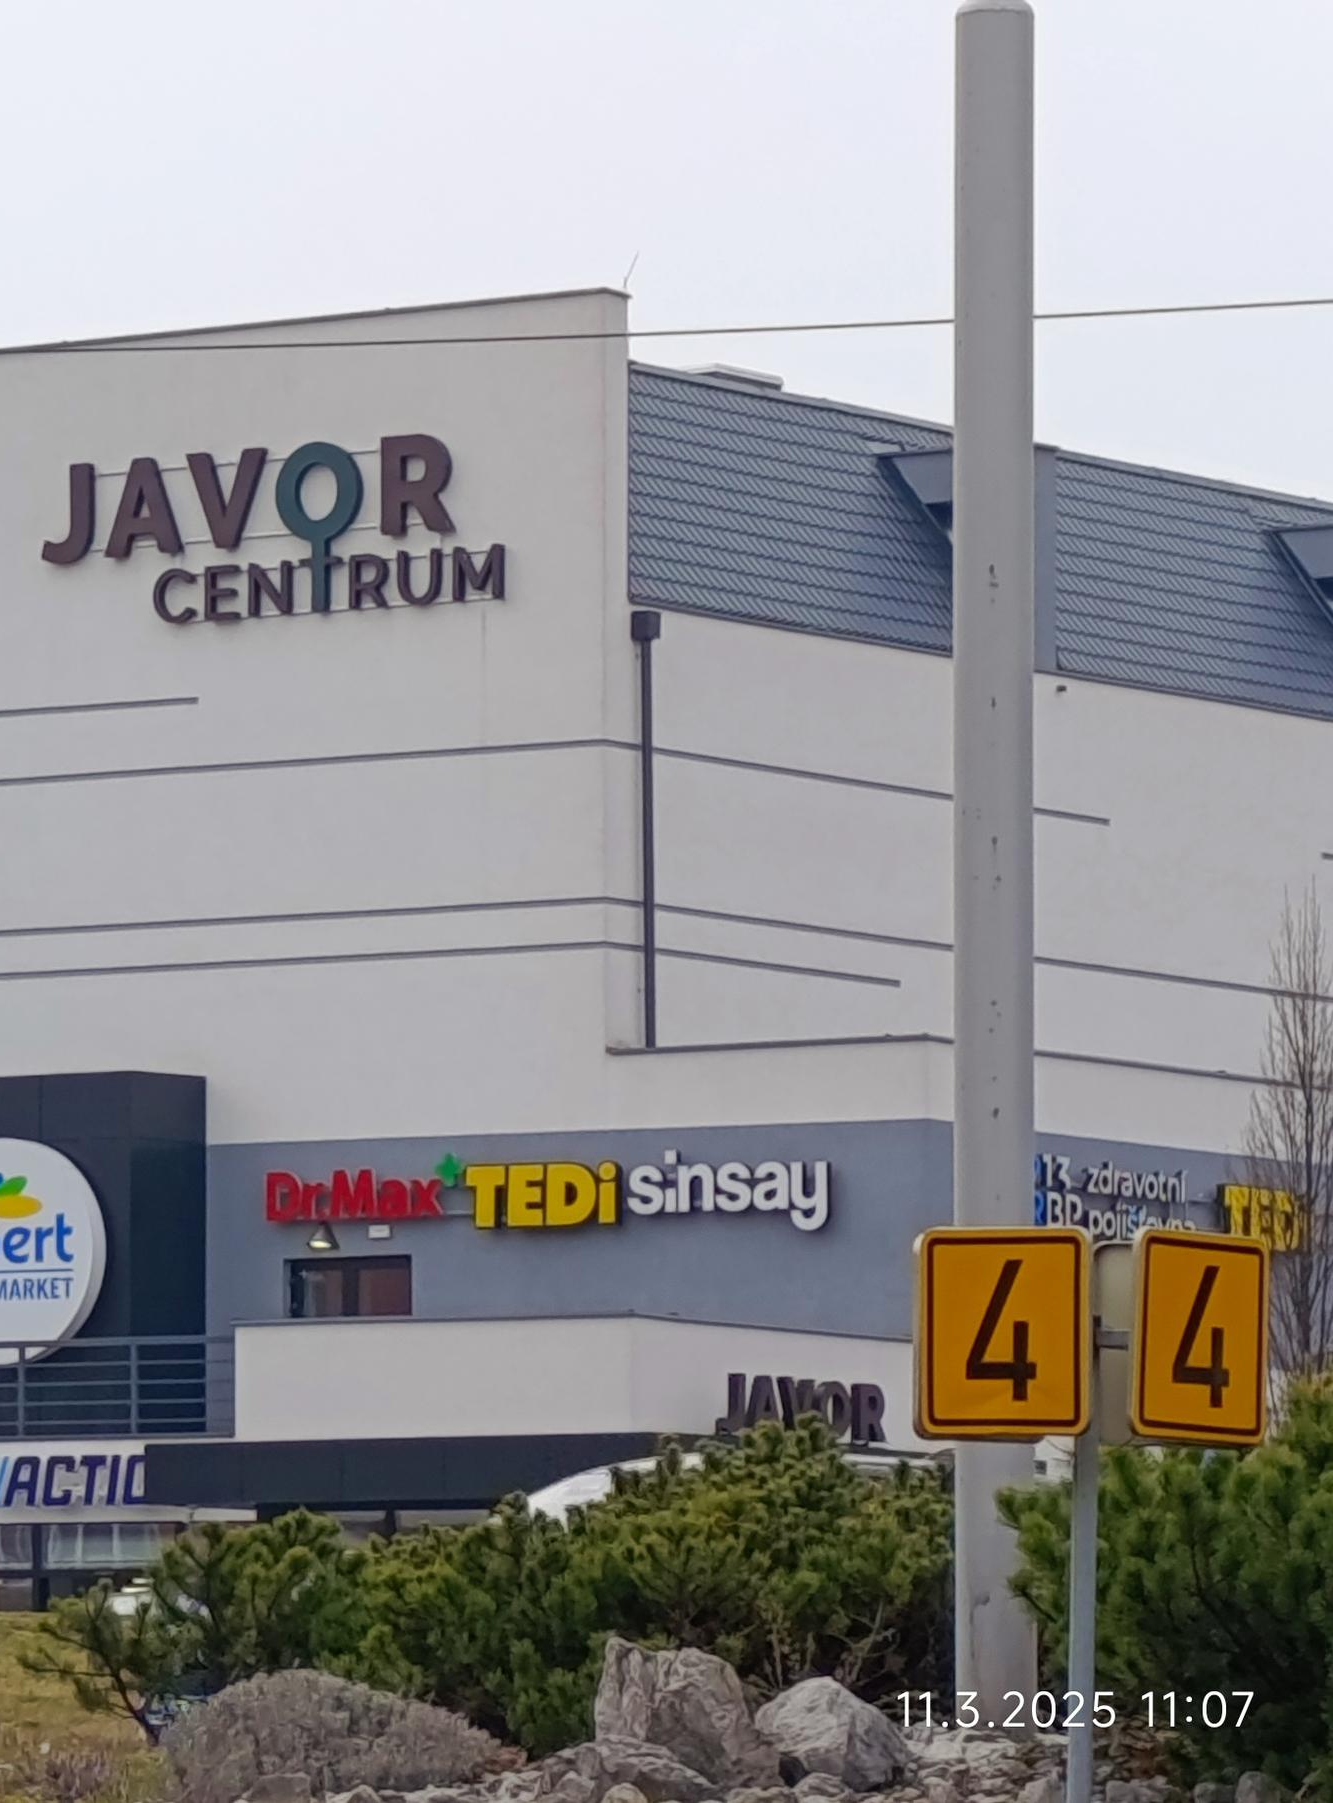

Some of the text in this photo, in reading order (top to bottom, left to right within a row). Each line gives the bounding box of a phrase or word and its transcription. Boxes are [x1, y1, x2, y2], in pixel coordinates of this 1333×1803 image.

[41, 433, 456, 566] JAVOR
[152, 543, 506, 626] CENTRUM
[464, 1160, 622, 1229] TEDi
[627, 1149, 830, 1231] sinsay
[1086, 1160, 1189, 1204] zdravotní
[1224, 1185, 1305, 1252] TED
[965, 1258, 1037, 1402] 4
[1171, 1264, 1230, 1409] 4
